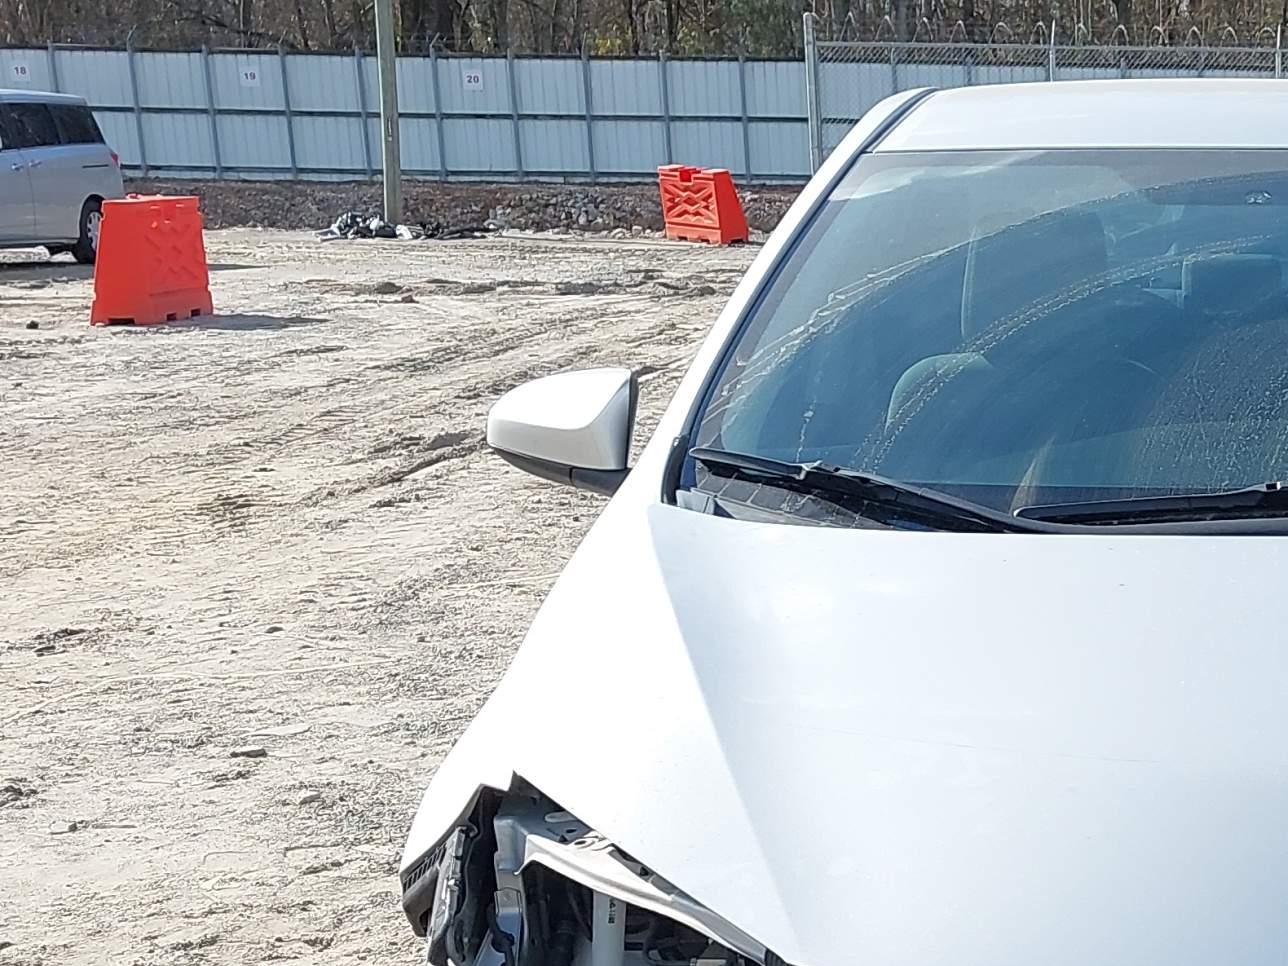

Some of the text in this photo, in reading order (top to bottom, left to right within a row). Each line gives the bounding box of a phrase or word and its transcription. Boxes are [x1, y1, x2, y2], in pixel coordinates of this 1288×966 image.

[14, 66, 26, 75] 18
[244, 71, 256, 80] 19
[466, 75, 480, 84] 20
